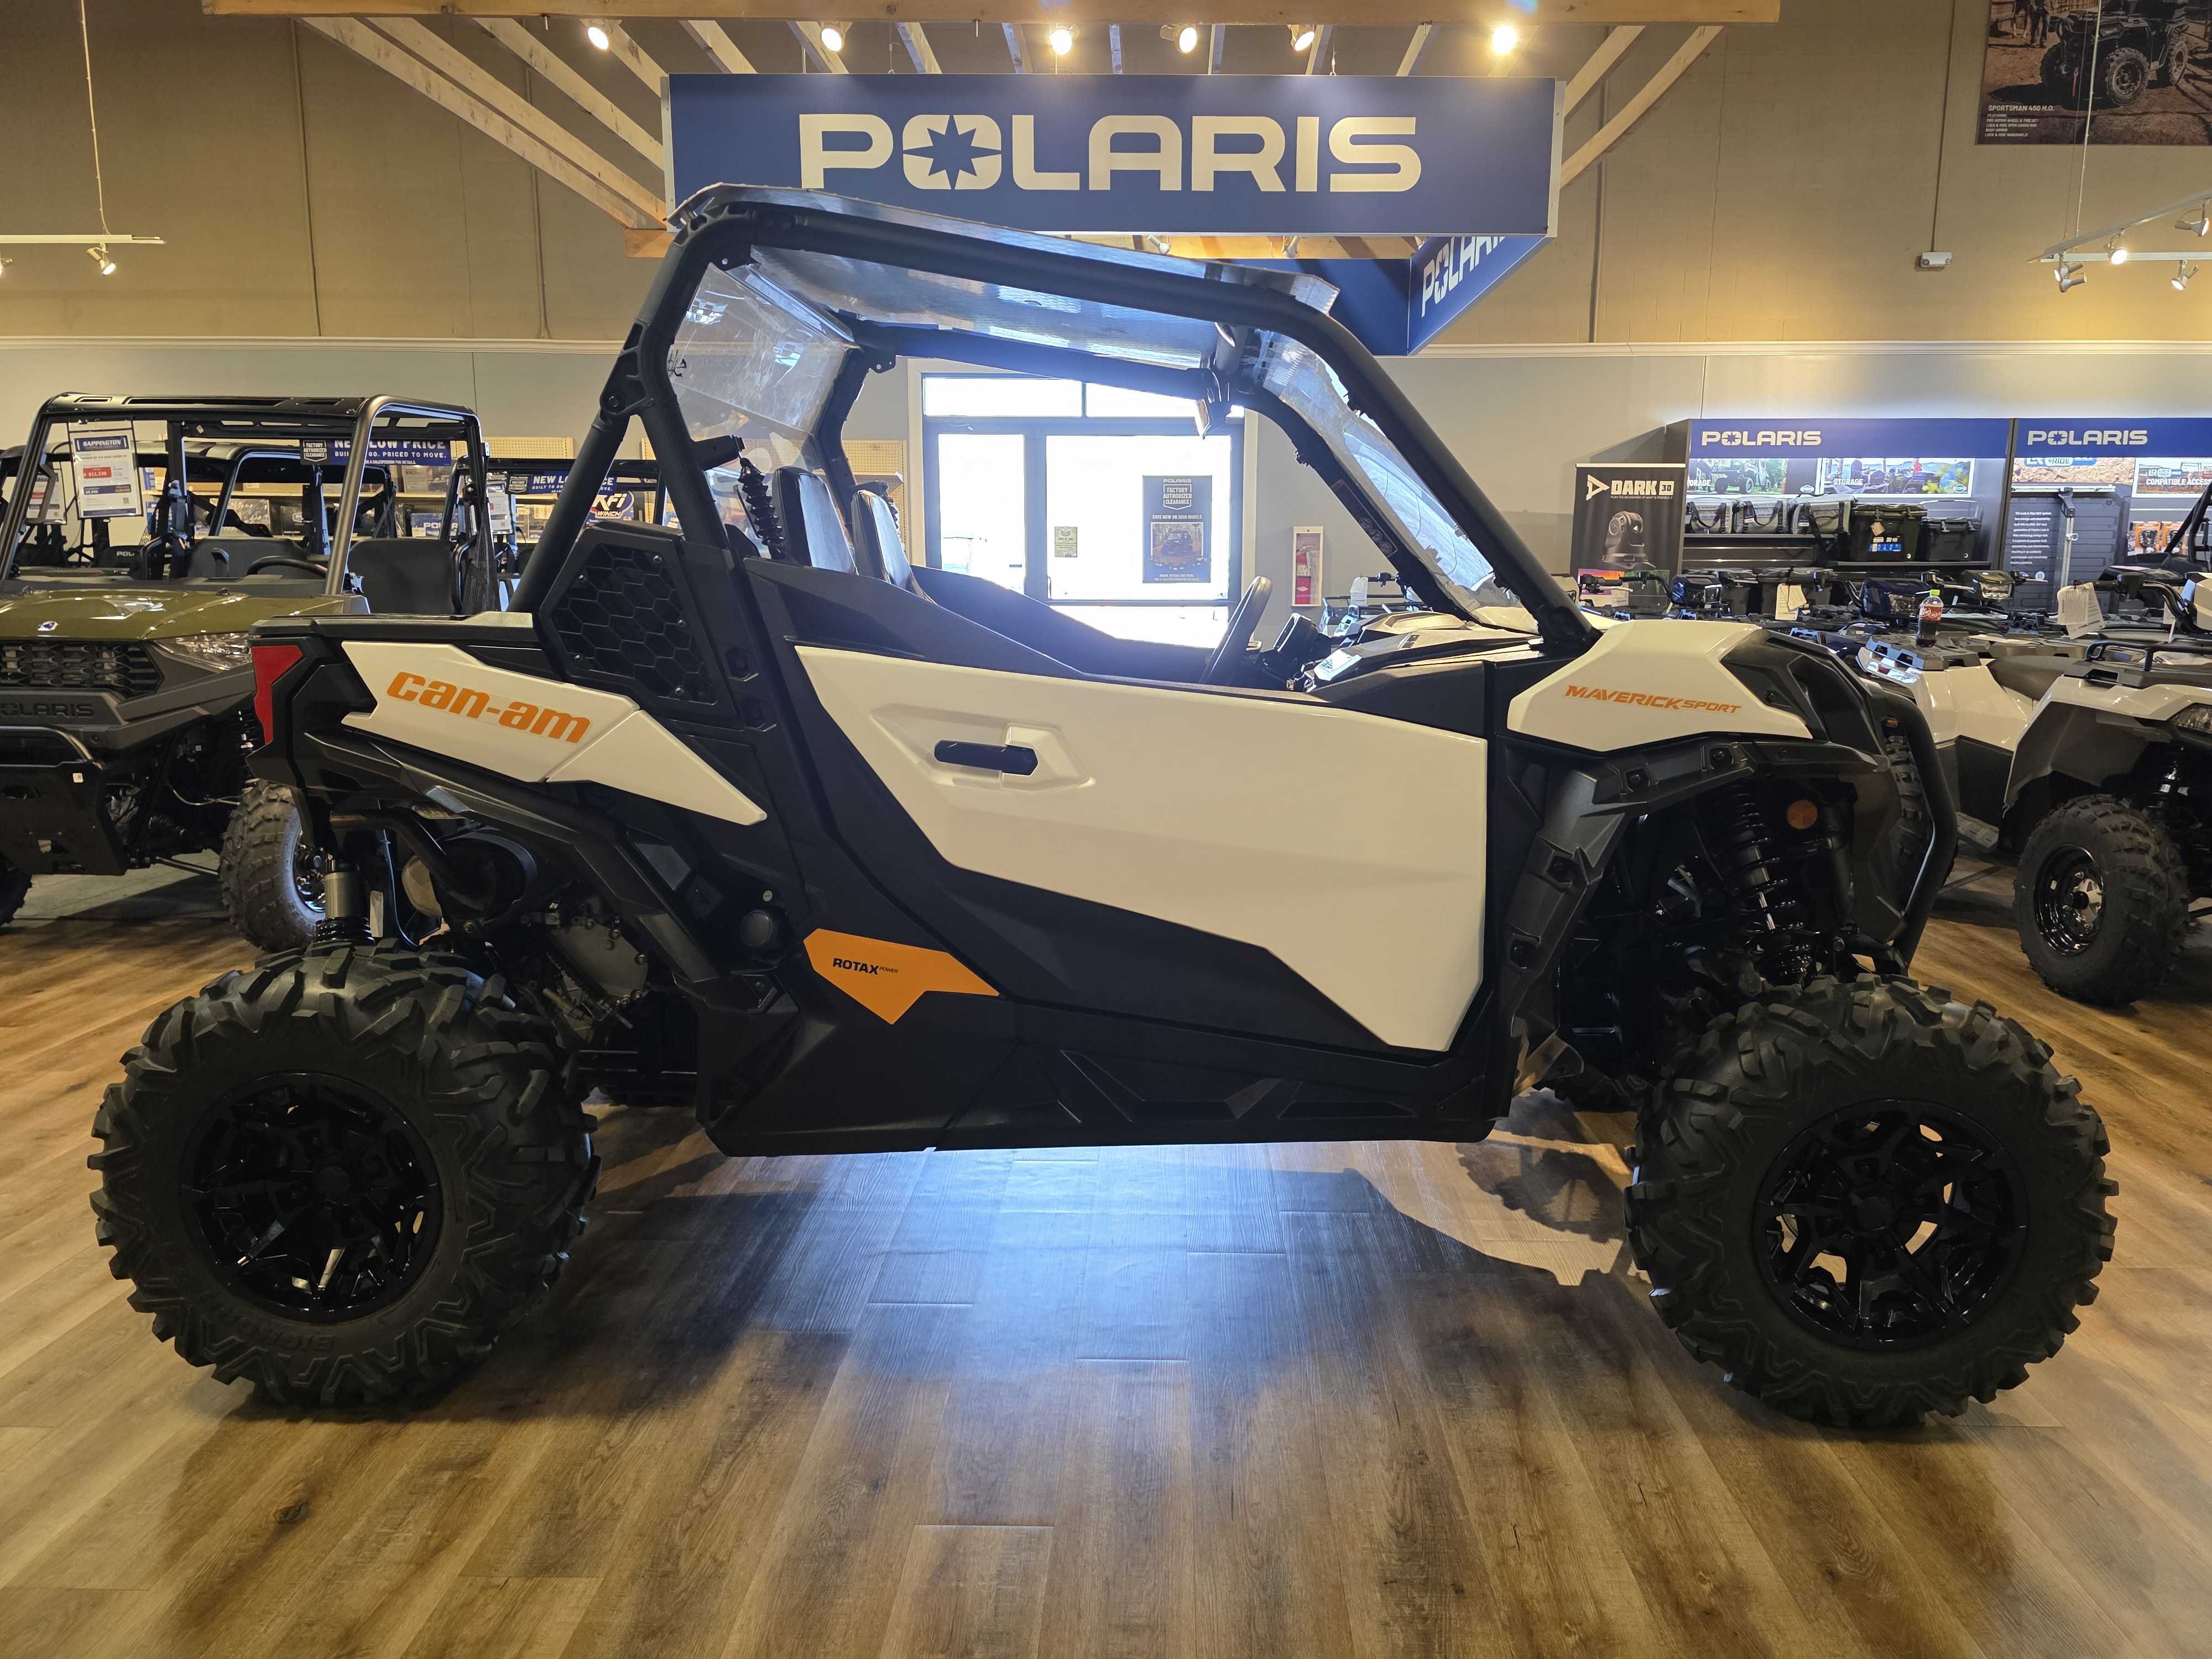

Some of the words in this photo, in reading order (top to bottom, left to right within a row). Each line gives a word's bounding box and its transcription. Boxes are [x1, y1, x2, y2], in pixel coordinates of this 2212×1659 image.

[799, 113, 1421, 192] POLARIS
[1421, 236, 1505, 318] POLAR
[83, 439, 121, 447] SAPPINGTON
[334, 440, 351, 449] NE
[1702, 431, 1821, 446] POLARIS
[2028, 430, 2148, 445] POLARIS
[533, 476, 555, 484] NEW
[1611, 481, 1657, 495] DARK
[1564, 685, 1684, 710] MAVERICK
[1681, 700, 1741, 713] SPORT
[387, 672, 591, 744] can-am
[833, 958, 879, 975] ROTAX
